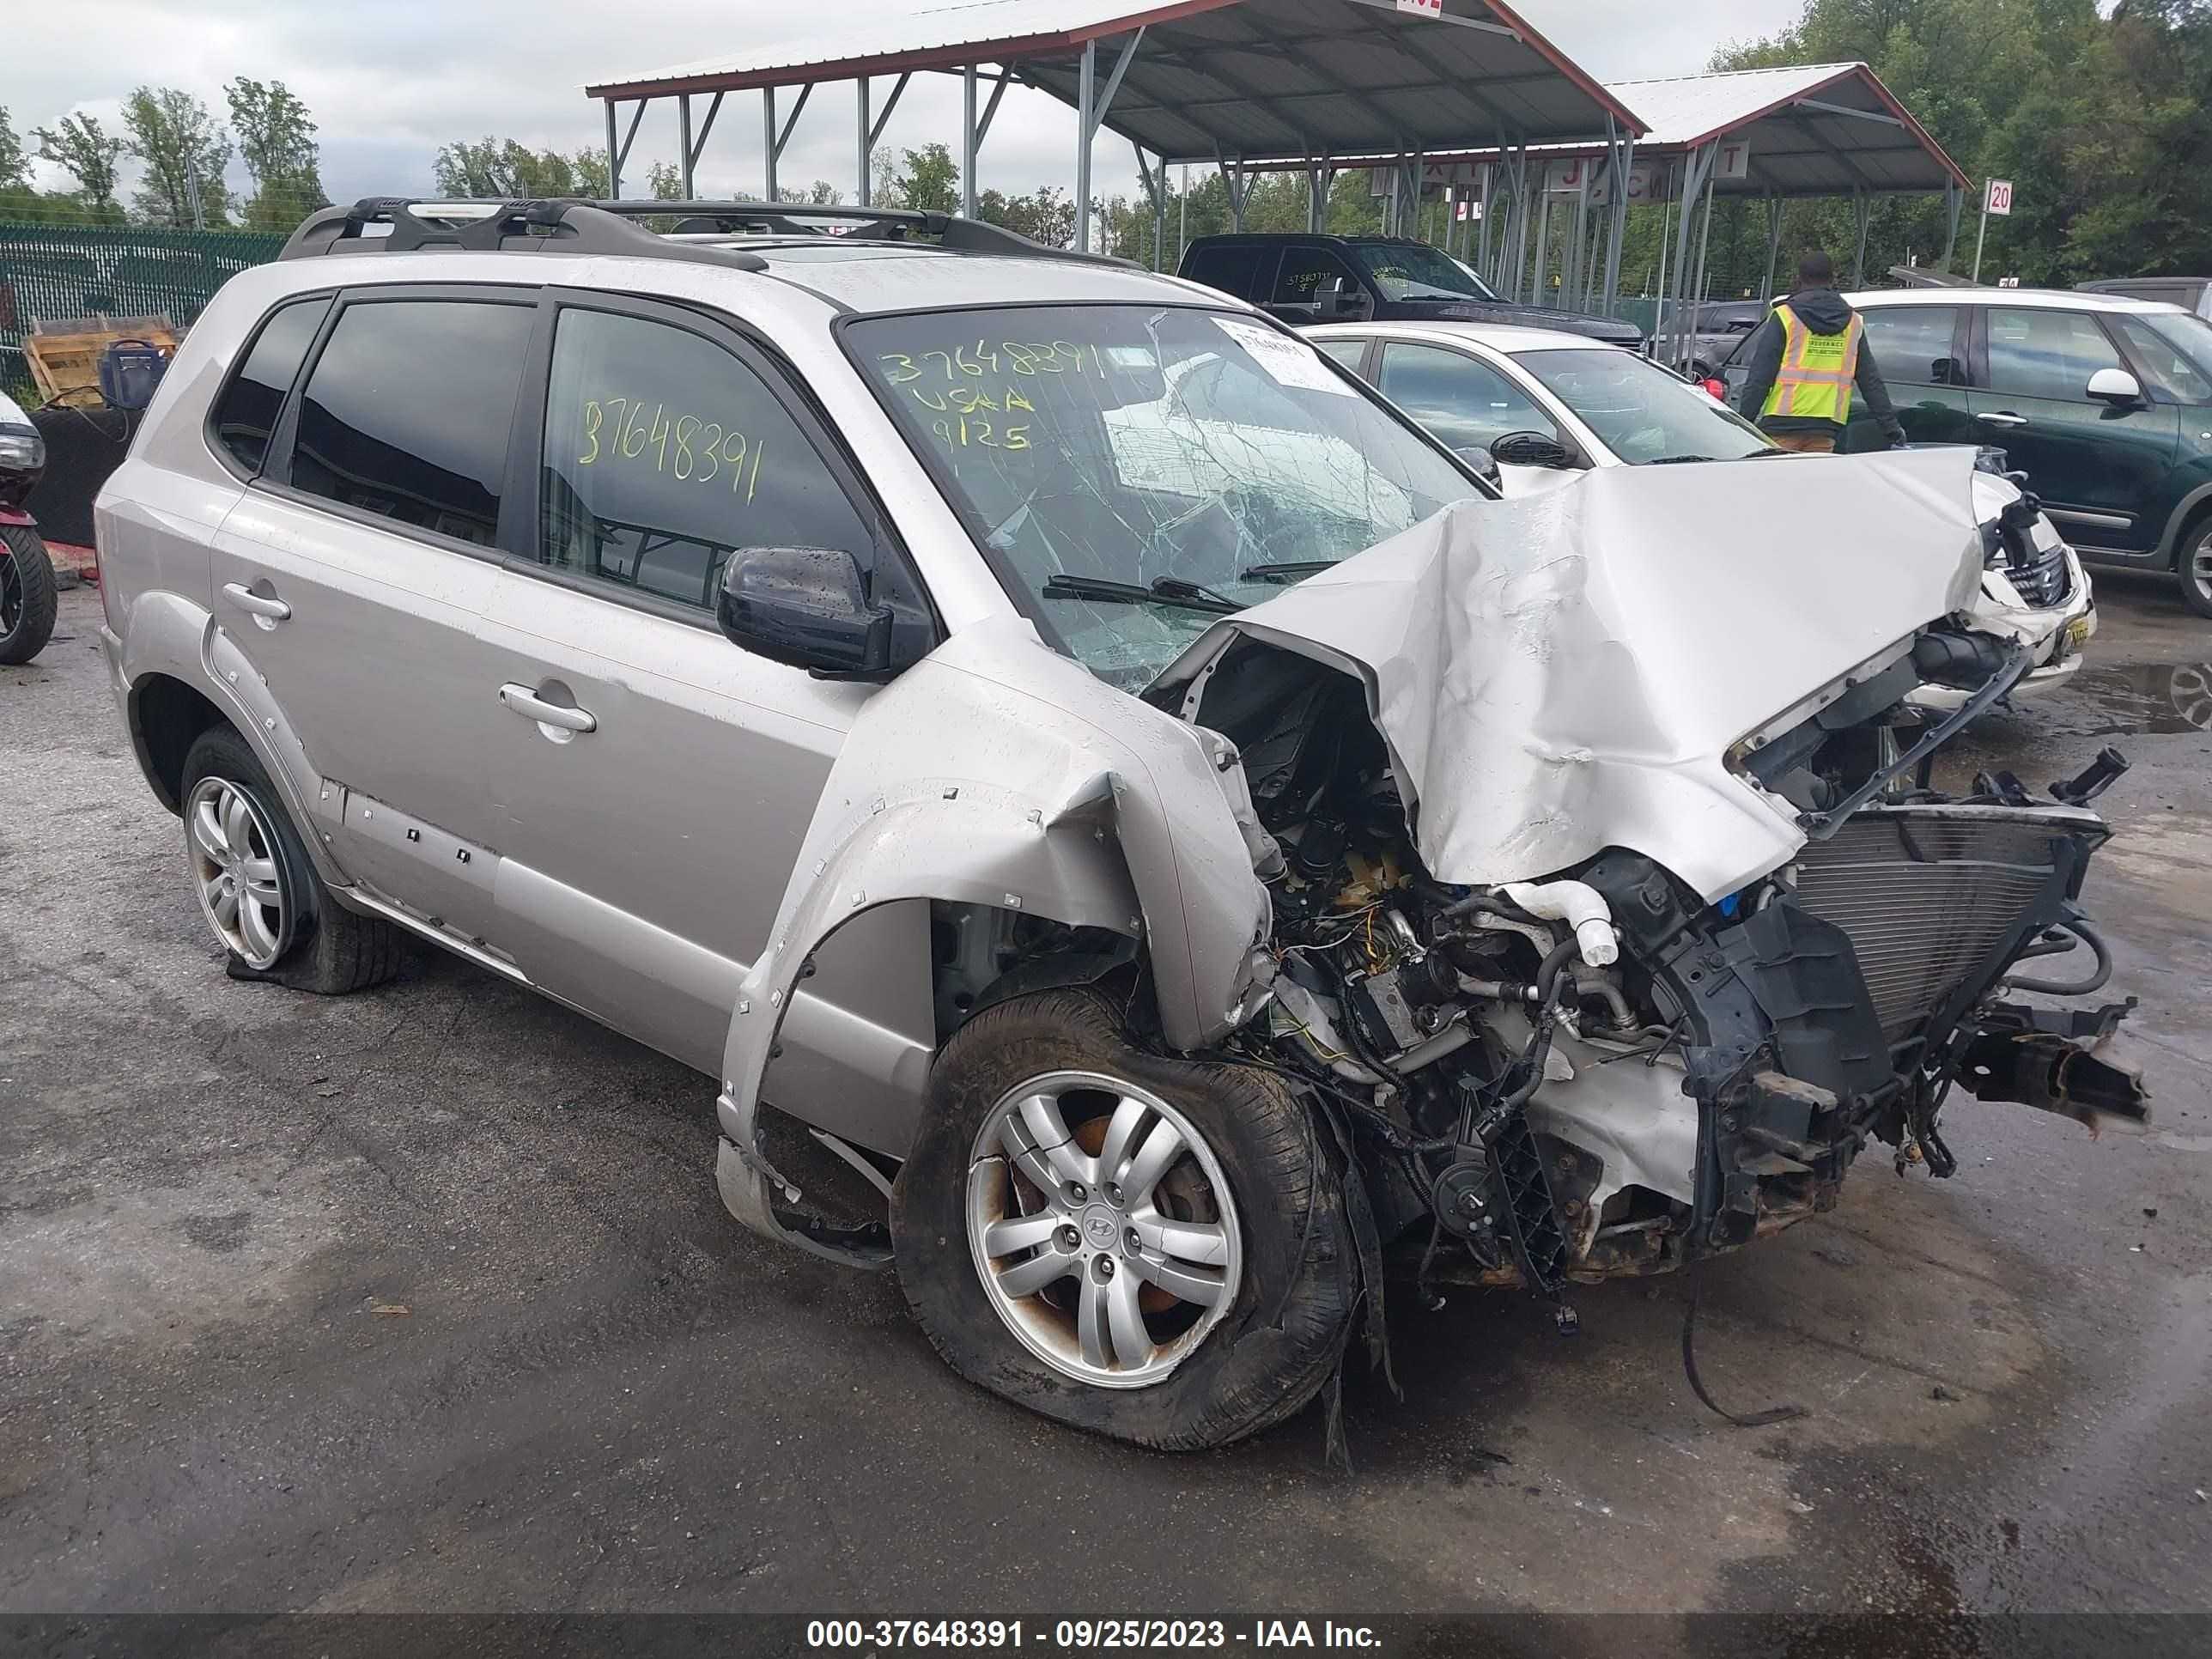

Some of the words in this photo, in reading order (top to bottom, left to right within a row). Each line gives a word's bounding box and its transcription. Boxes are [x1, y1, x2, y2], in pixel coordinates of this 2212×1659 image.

[1990, 185, 2010, 209] 20
[878, 338, 1106, 382] 37648391
[908, 386, 1036, 414] USAA
[577, 397, 764, 507] 37648391
